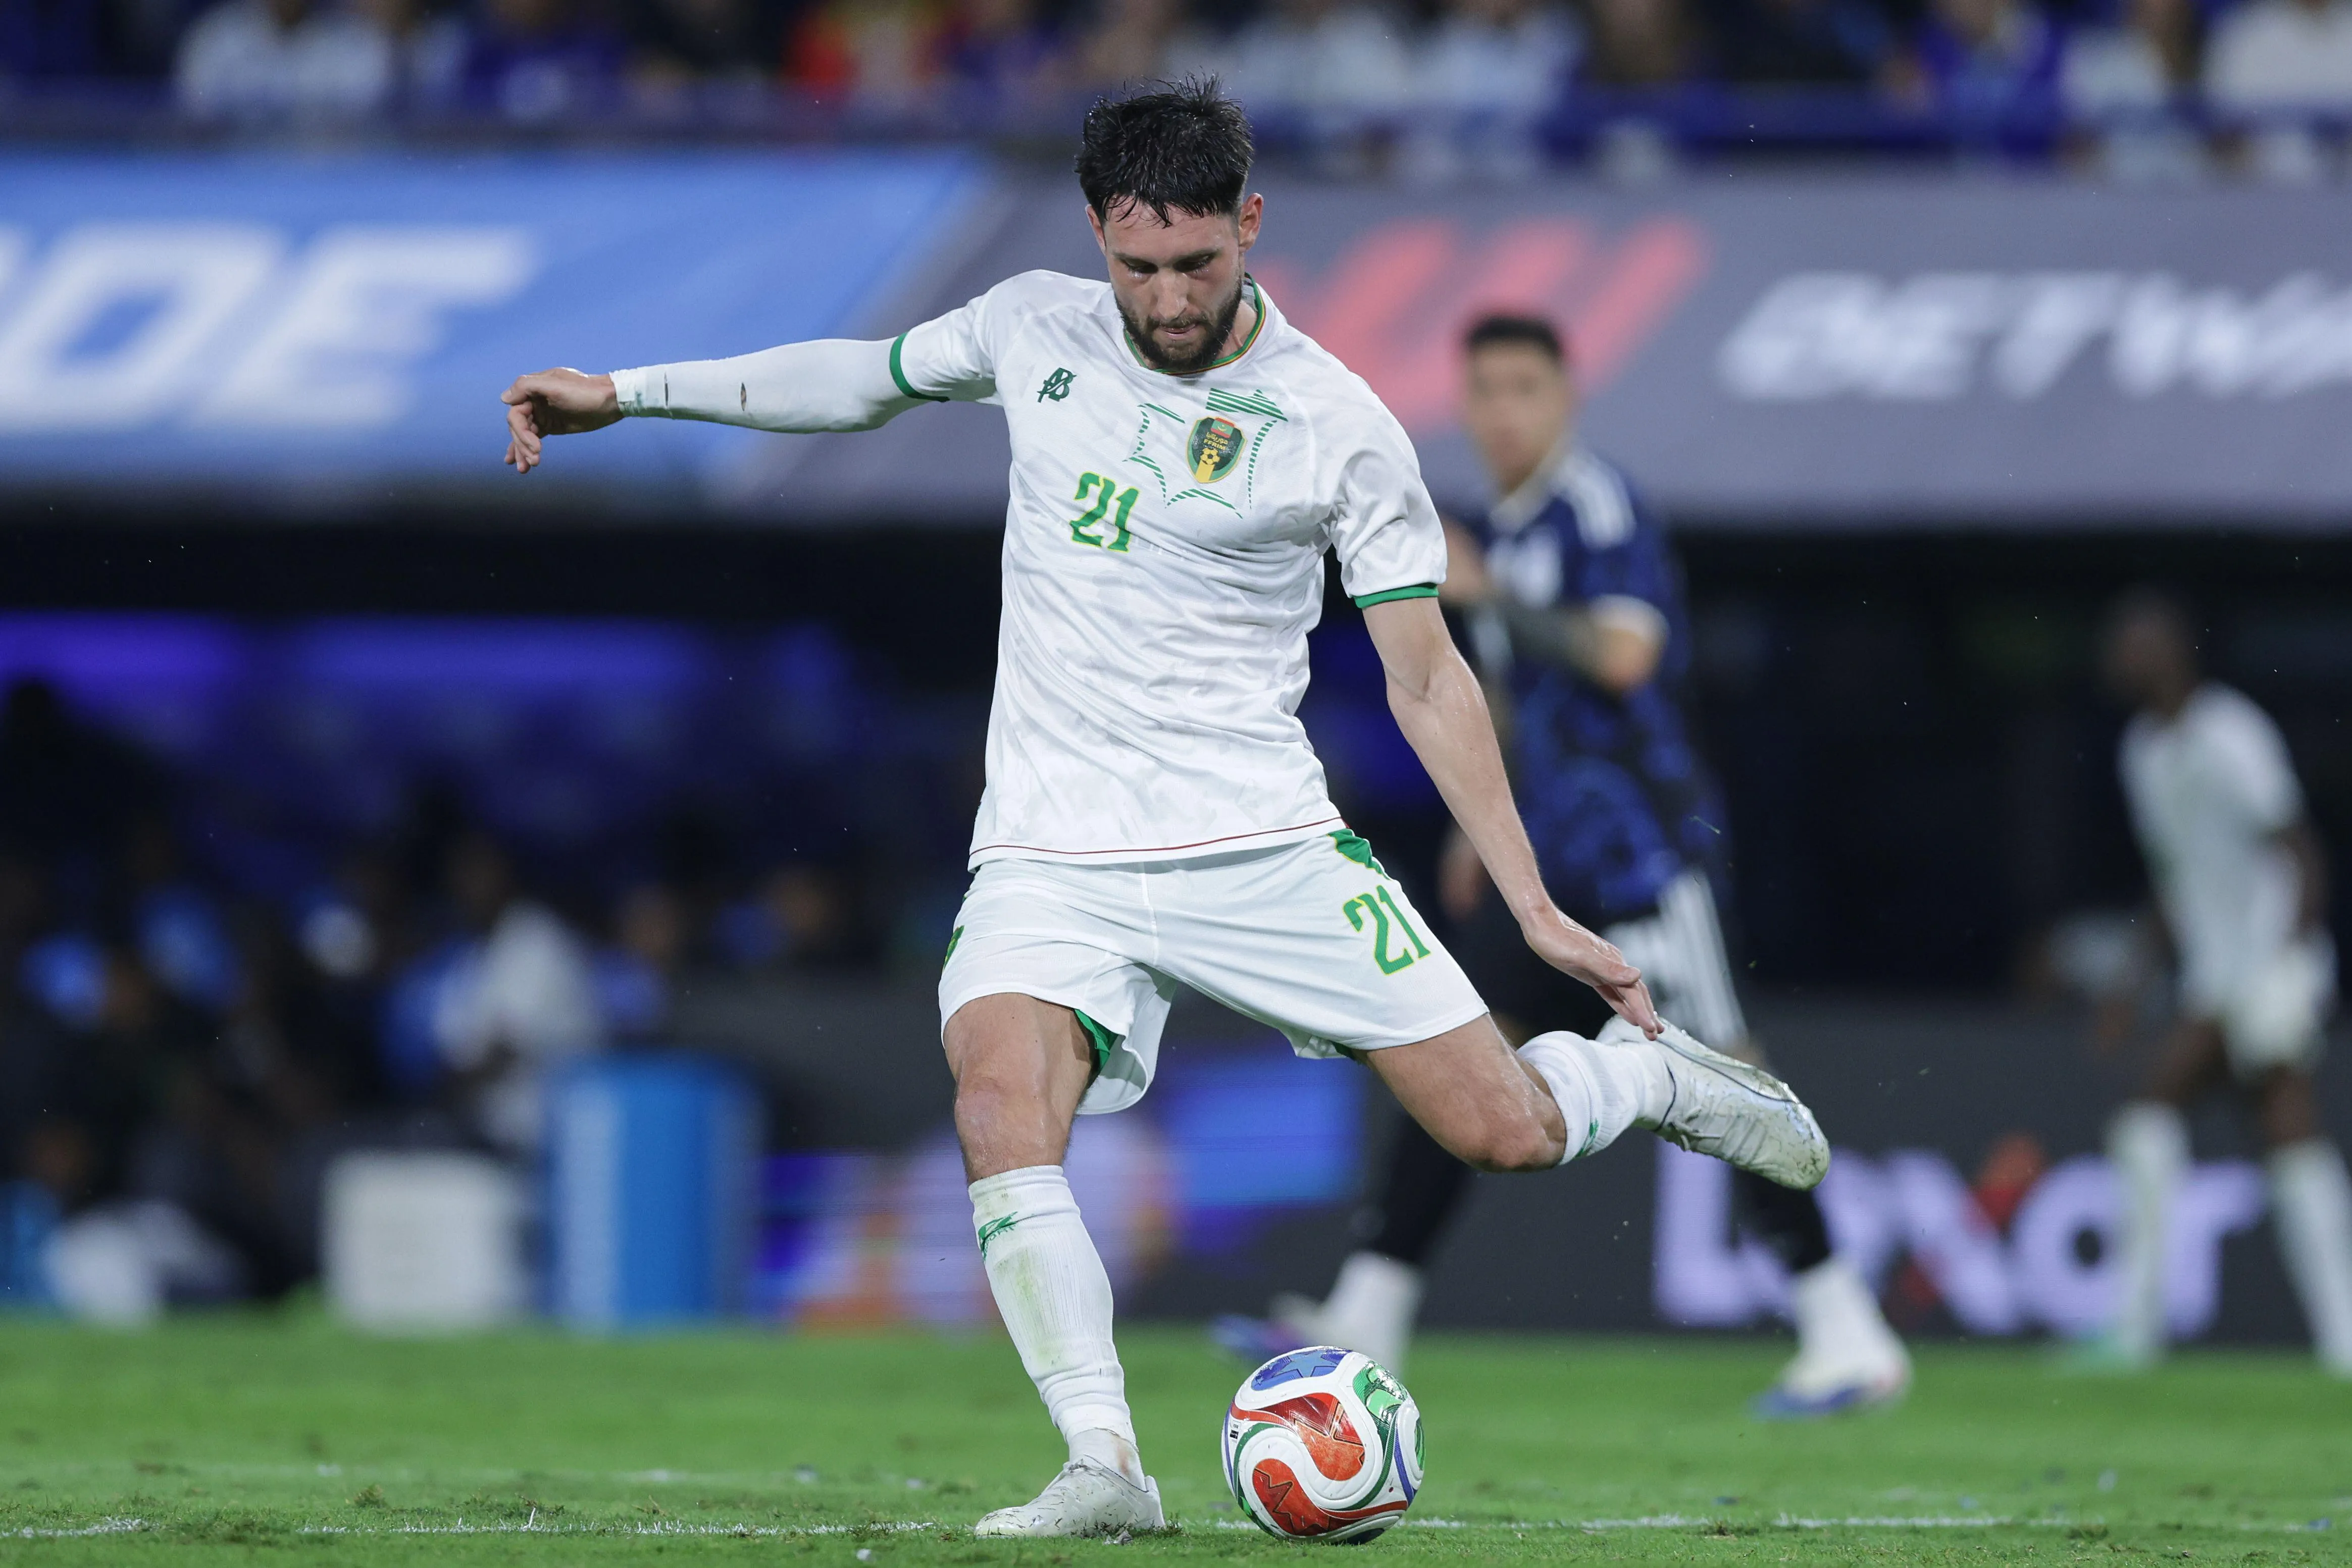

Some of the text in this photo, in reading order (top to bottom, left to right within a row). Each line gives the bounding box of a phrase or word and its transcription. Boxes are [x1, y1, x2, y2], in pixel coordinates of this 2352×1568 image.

[0, 222, 540, 434] DE
[1203, 439, 1226, 450] FFRIM
[1069, 471, 1139, 553] 21
[1343, 884, 1431, 975] 21
